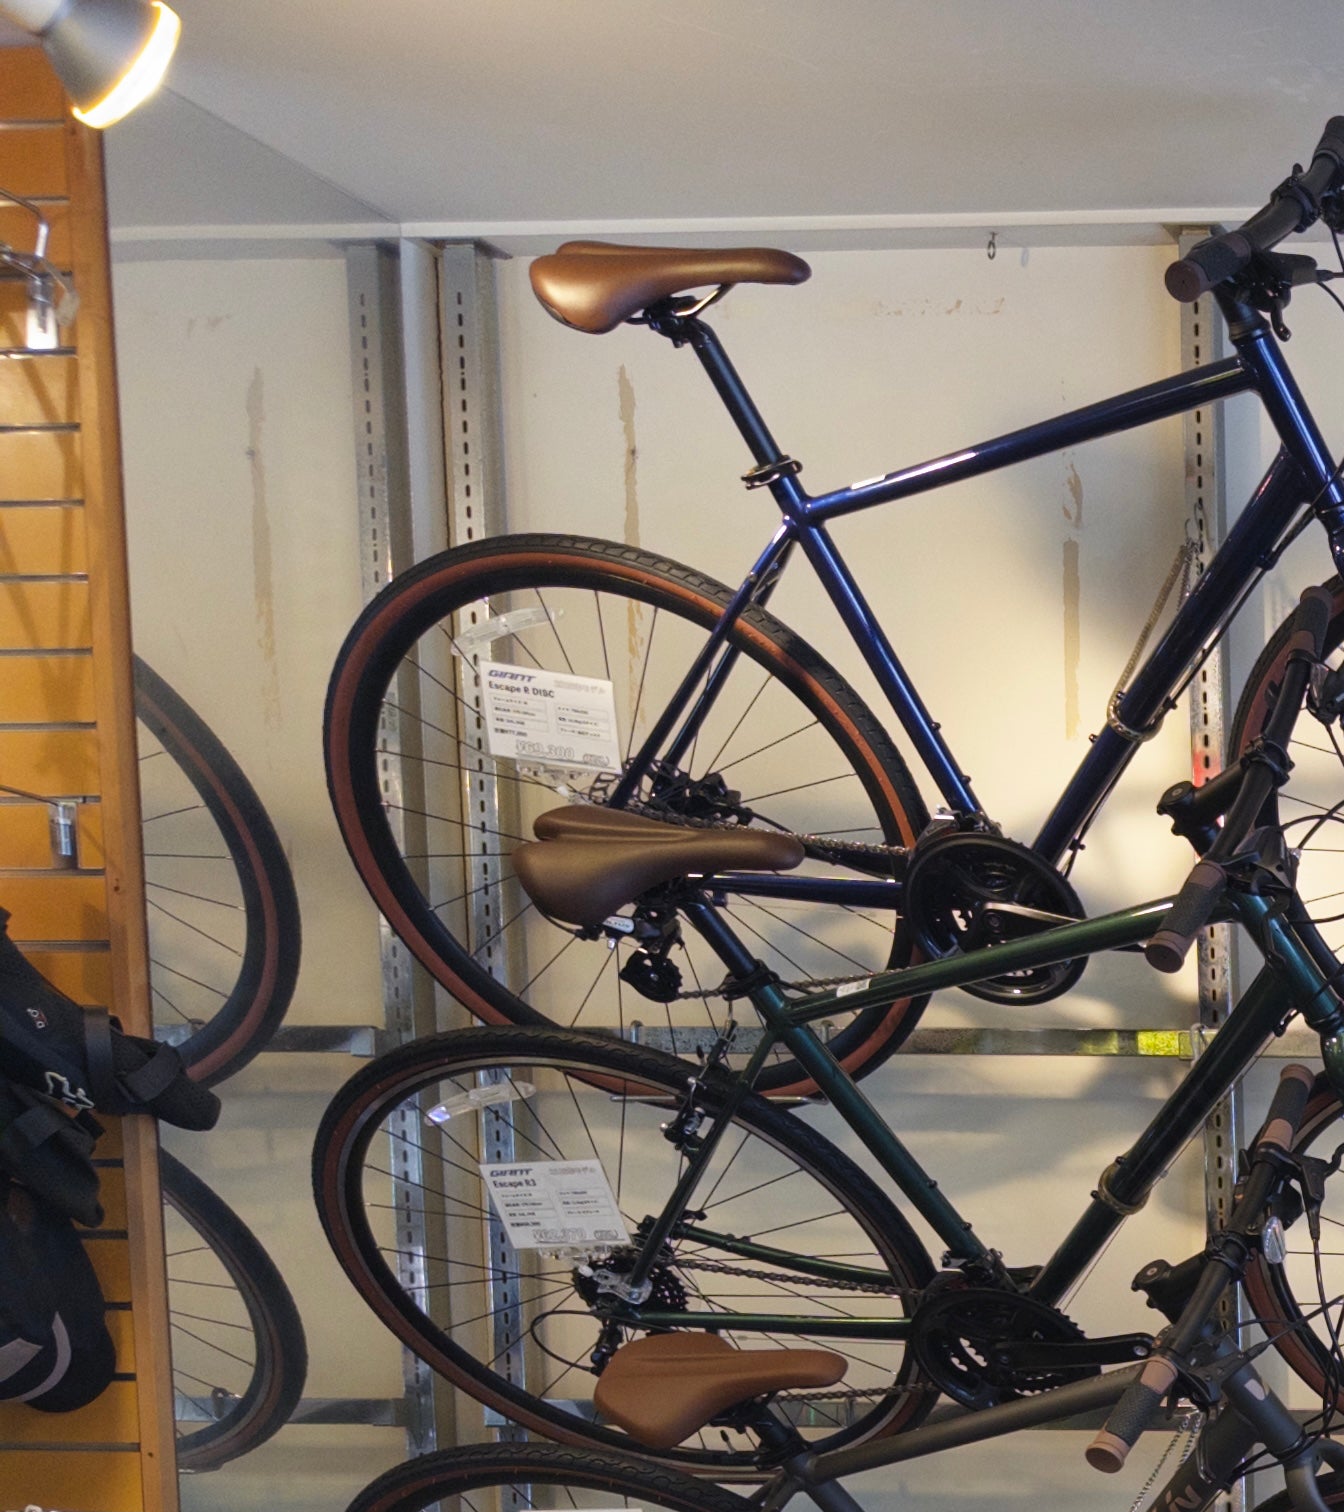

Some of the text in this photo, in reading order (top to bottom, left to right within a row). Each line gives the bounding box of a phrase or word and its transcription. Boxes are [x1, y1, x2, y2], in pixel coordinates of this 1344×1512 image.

[488, 669, 536, 682] GIANT
[488, 681, 521, 694] Escape
[532, 687, 555, 698] DISC
[490, 1168, 533, 1177] GIANT
[493, 1180, 523, 1189] Escape
